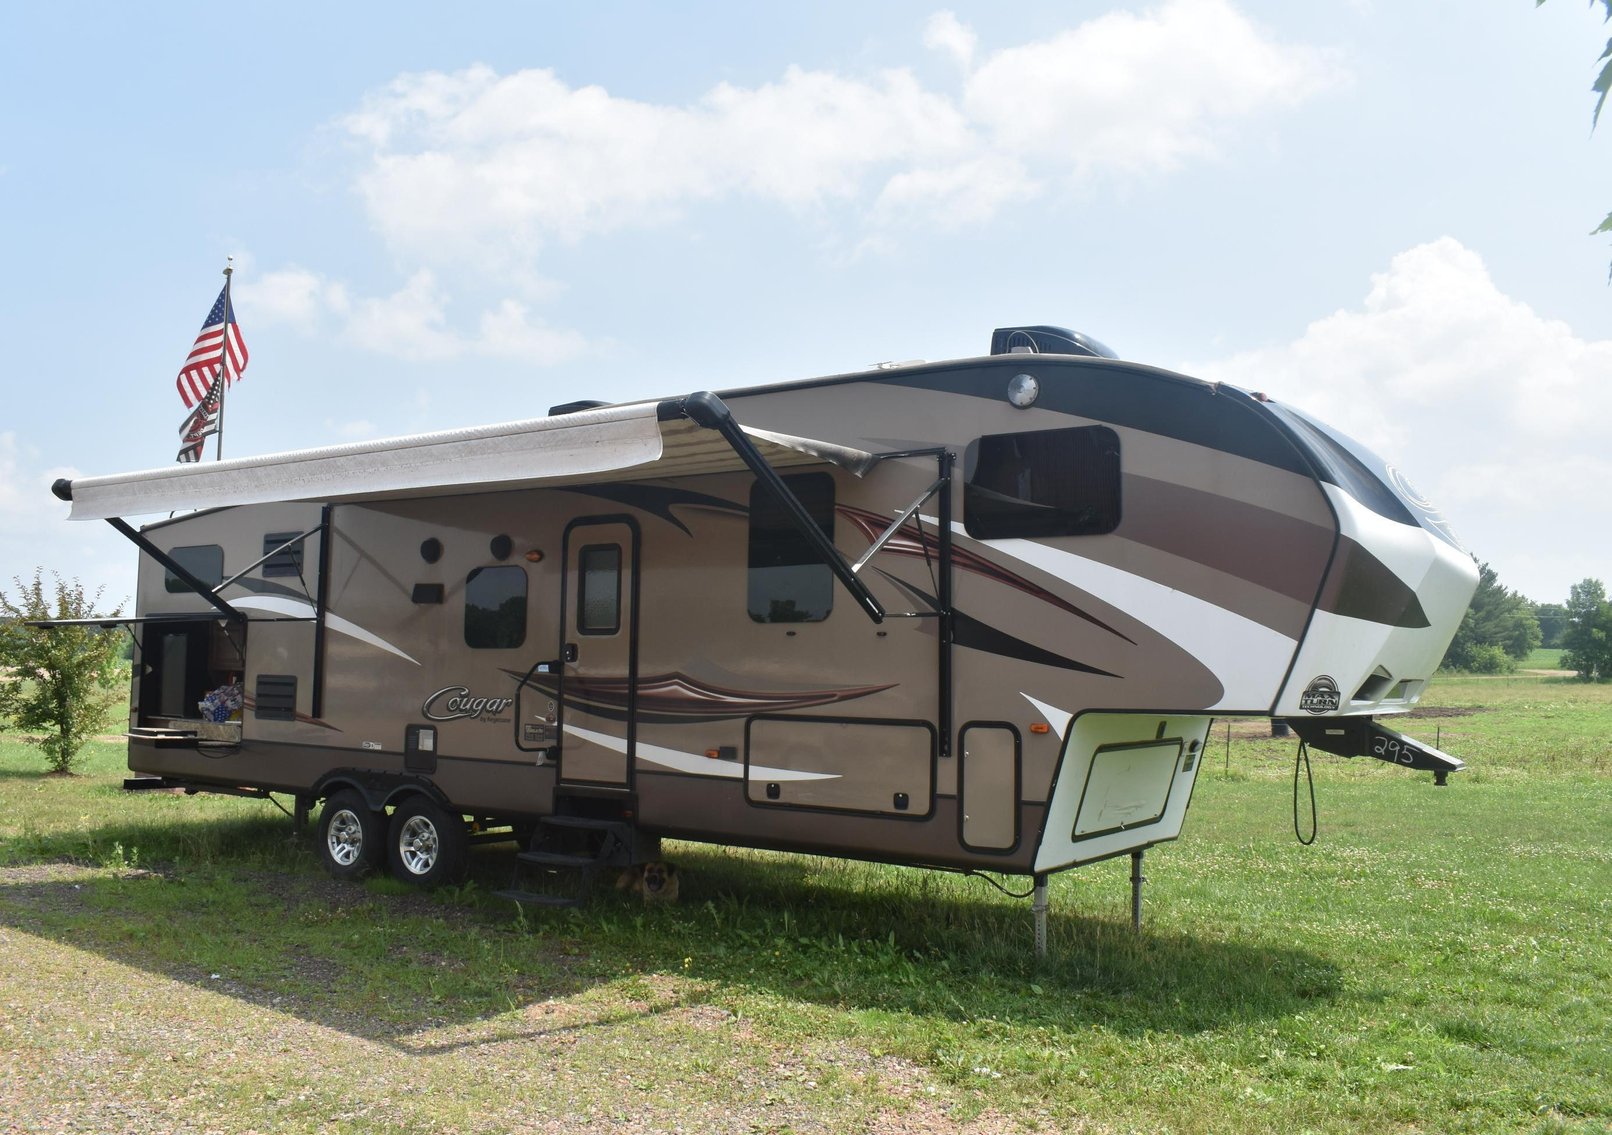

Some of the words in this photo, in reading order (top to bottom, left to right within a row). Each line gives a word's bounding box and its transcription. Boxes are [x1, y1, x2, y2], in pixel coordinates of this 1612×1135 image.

[423, 685, 513, 720] Cougar
[1302, 698, 1338, 706] TURN
[1374, 736, 1420, 764] 295
